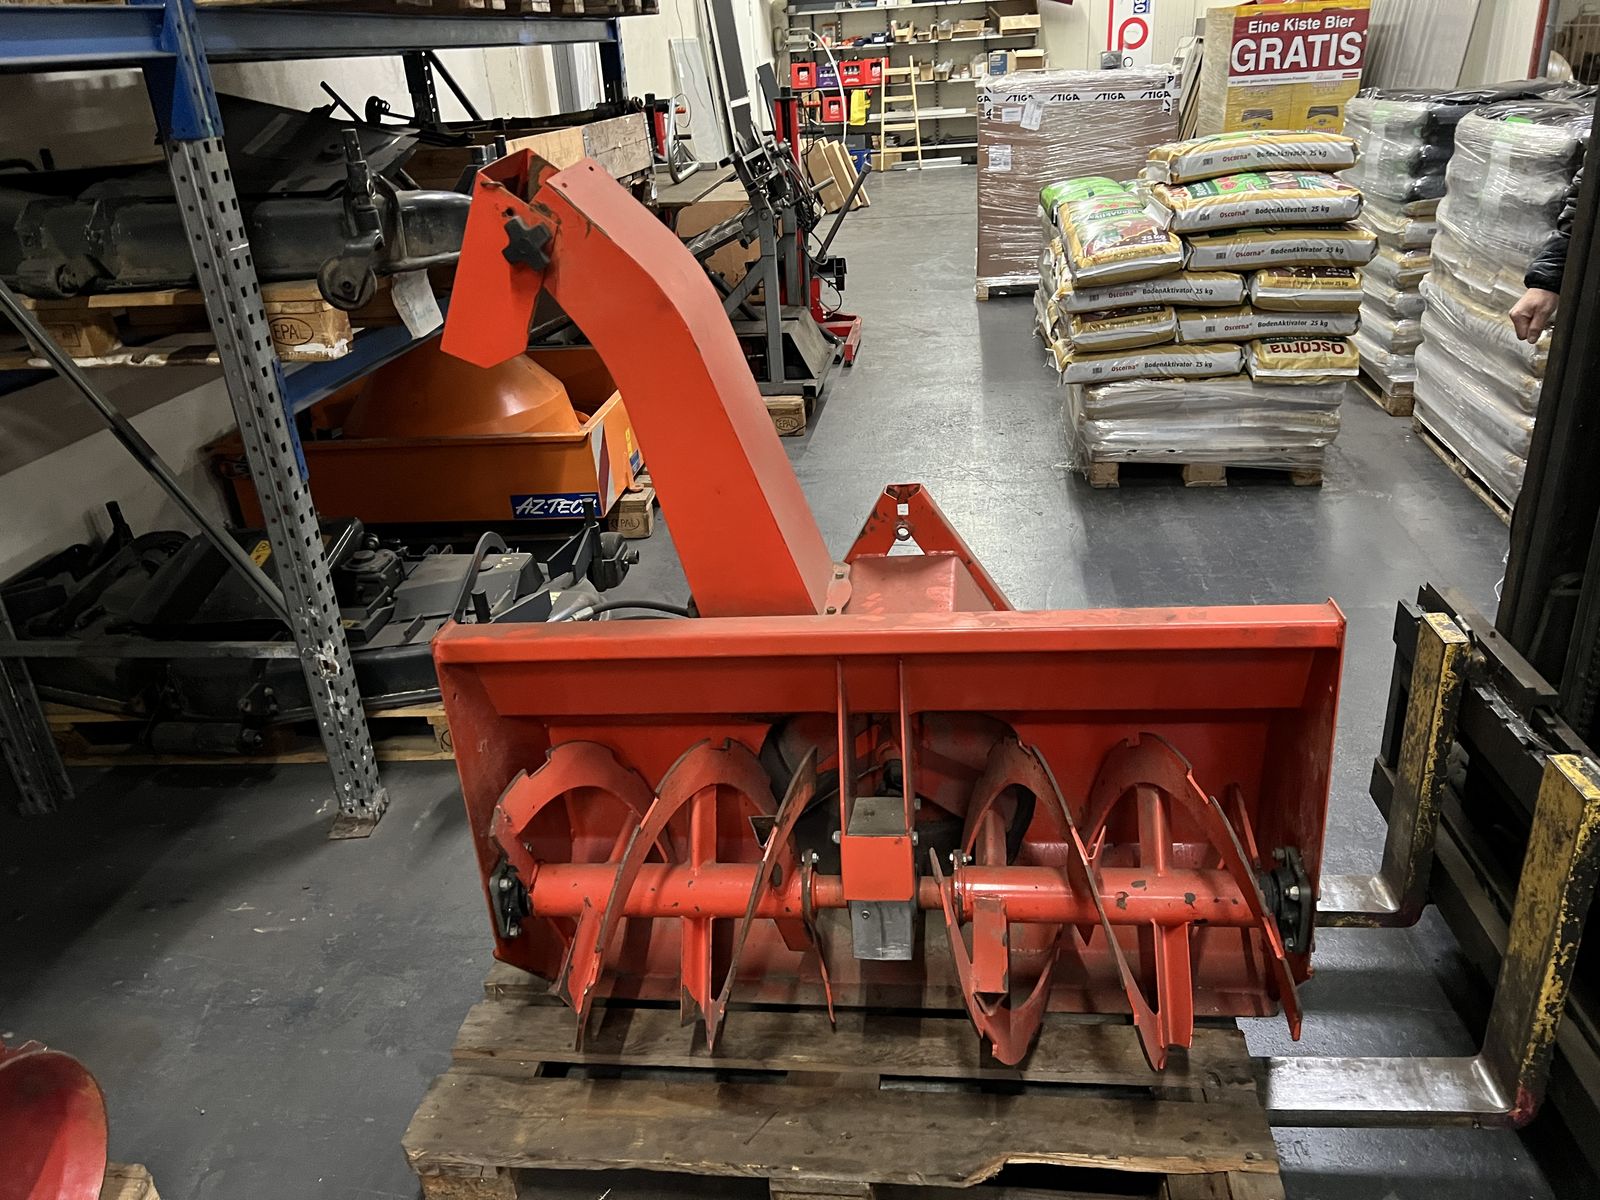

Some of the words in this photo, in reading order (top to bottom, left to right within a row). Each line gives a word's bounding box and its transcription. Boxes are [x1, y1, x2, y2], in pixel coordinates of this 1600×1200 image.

[1248, 20, 1280, 34] Eine
[1283, 17, 1321, 32] Kiste
[1325, 15, 1355, 29] Bier
[1095, 92, 1125, 100] STIGA
[1140, 91, 1171, 99] STIGA
[1321, 205, 1330, 214] kg
[1334, 246, 1344, 254] kg
[1204, 288, 1213, 296] kg
[1319, 320, 1329, 328] kg
[272, 324, 308, 339] EPAL
[1204, 361, 1213, 369] kg
